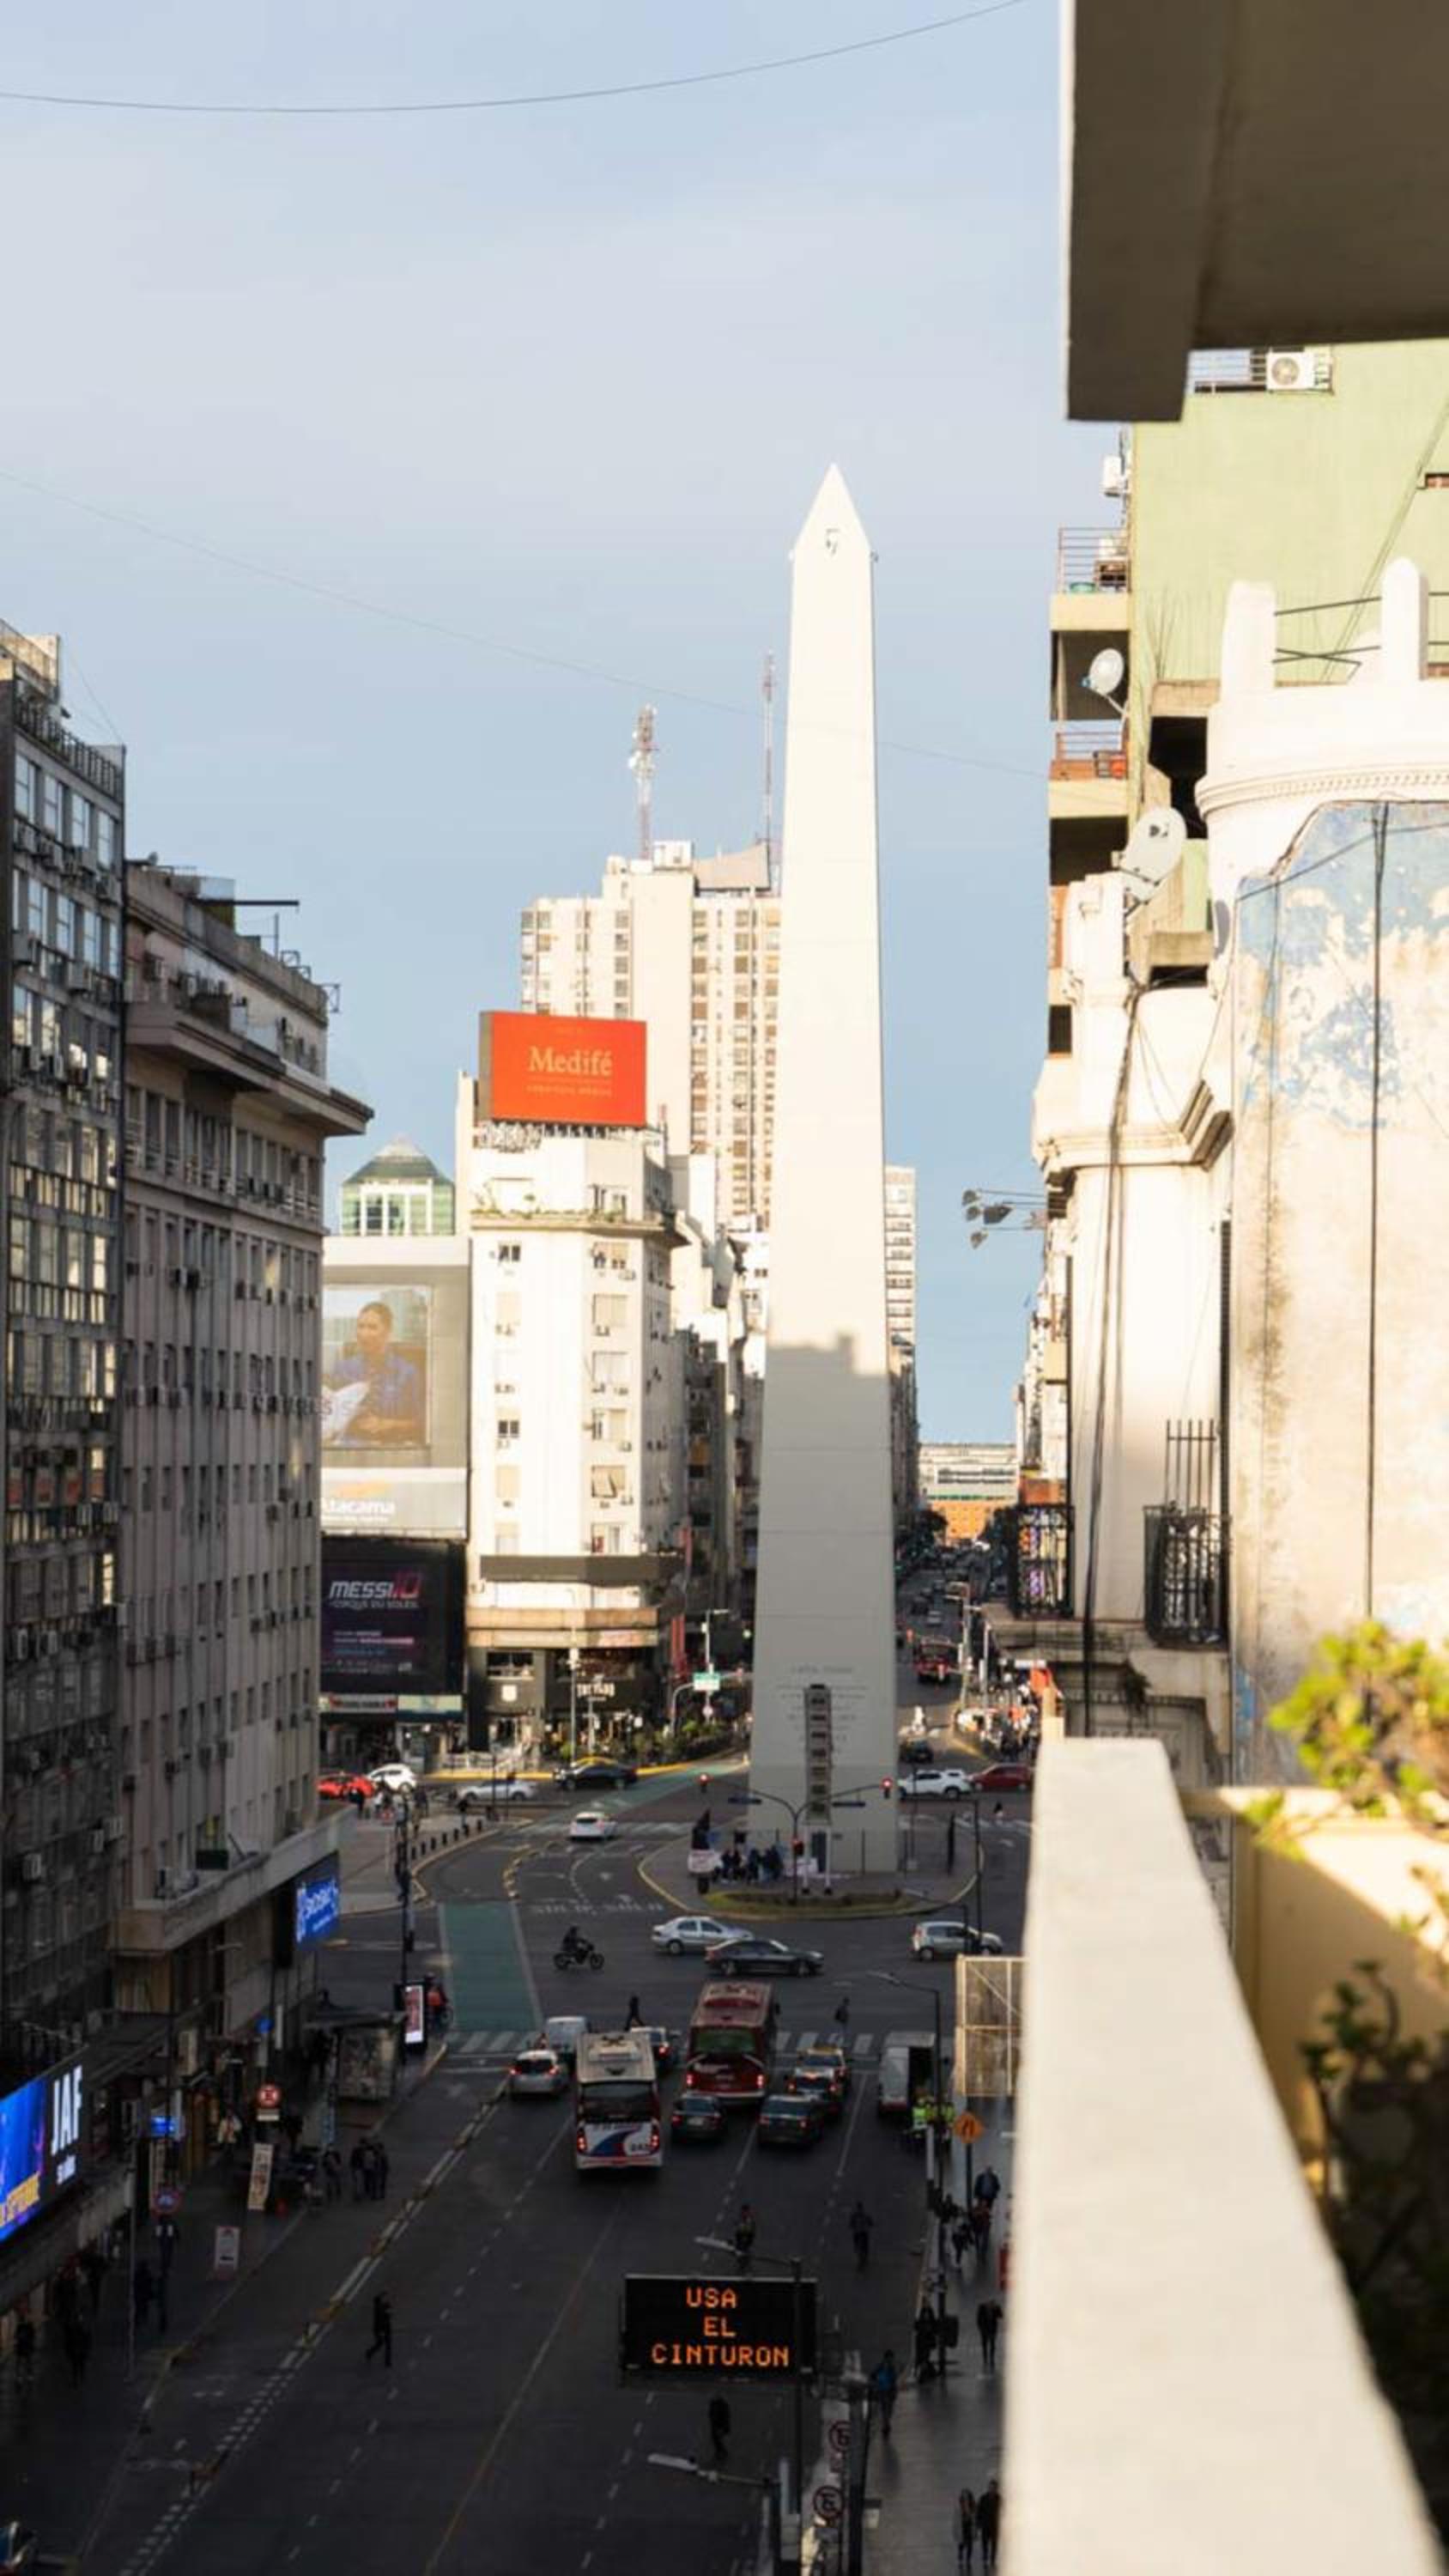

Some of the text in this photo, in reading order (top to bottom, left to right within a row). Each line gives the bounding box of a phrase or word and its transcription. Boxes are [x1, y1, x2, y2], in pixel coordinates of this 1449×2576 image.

[527, 1045, 613, 1077] Medifé
[686, 2287, 737, 2308] USA
[703, 2316, 737, 2337] EL
[652, 2343, 790, 2367] CINTURON
